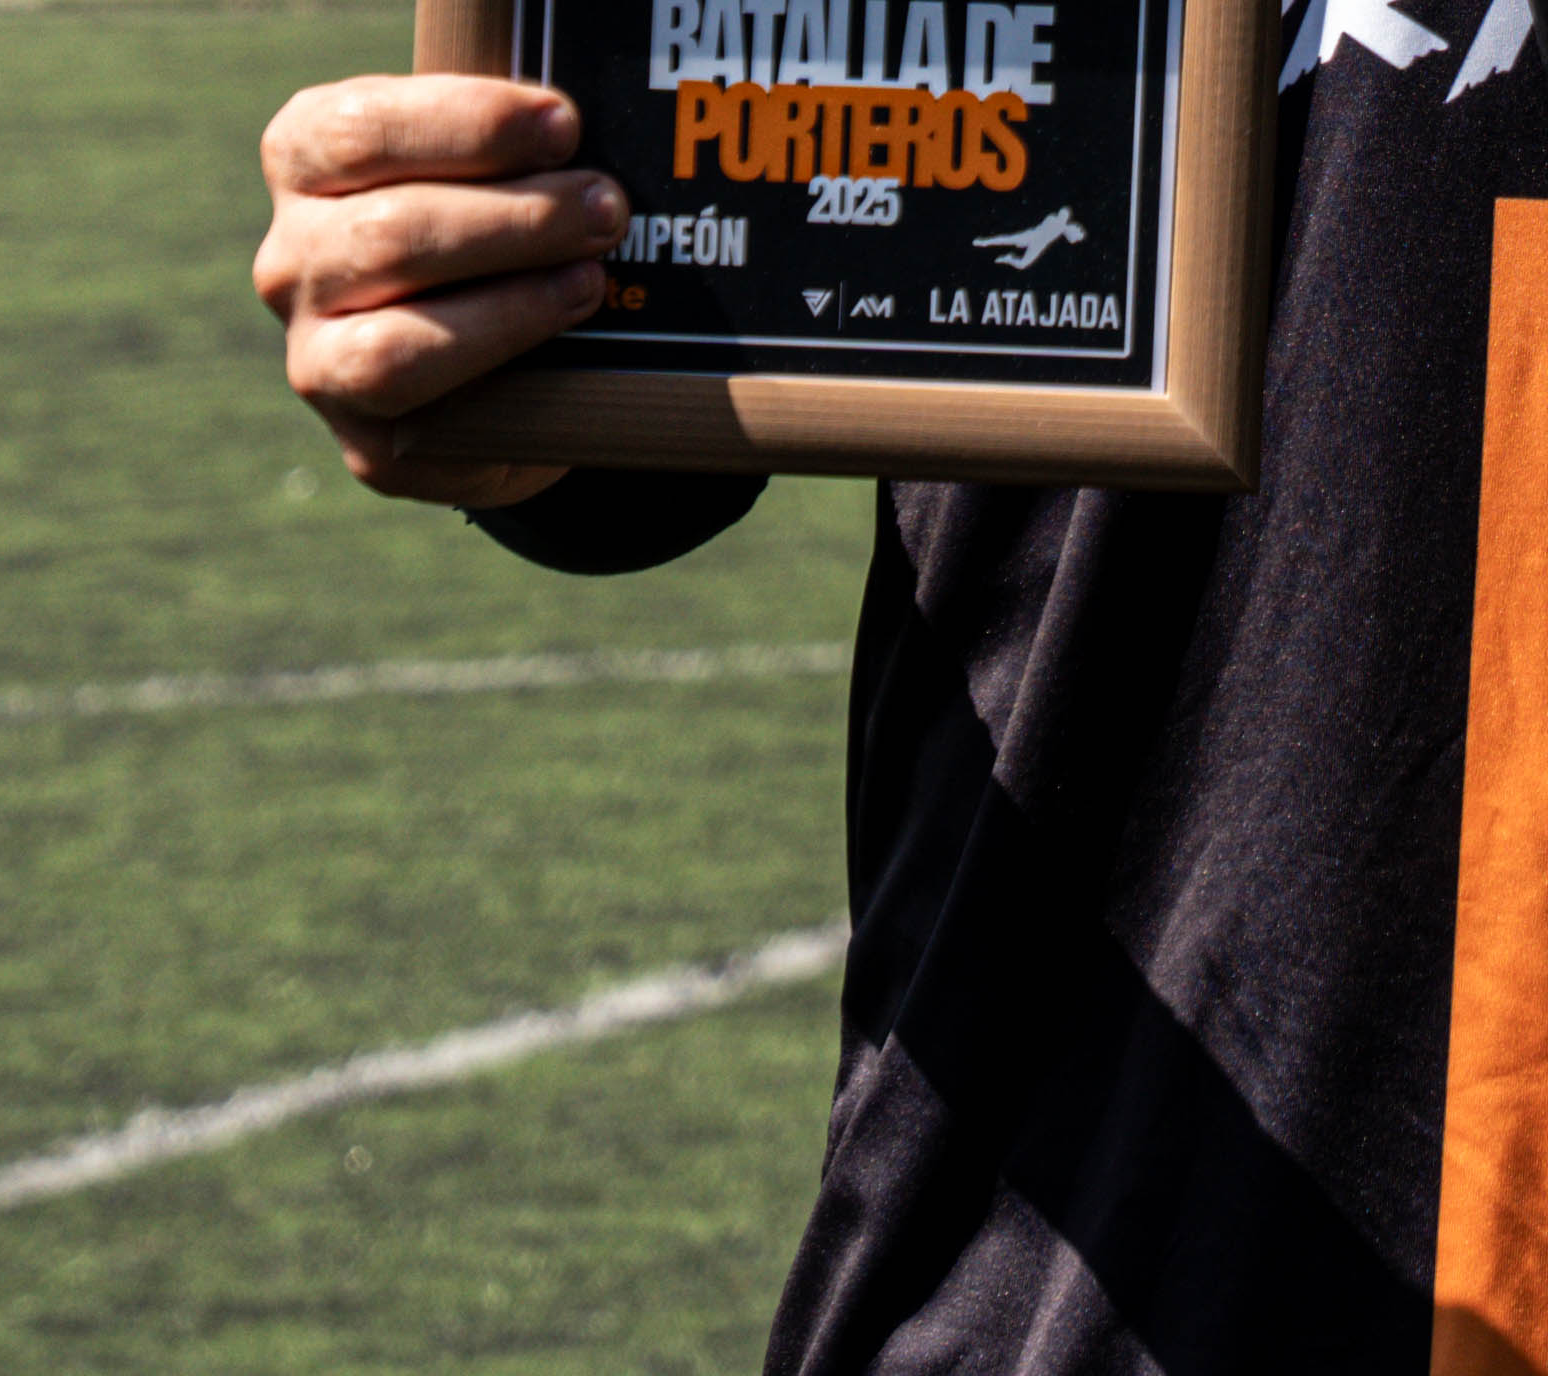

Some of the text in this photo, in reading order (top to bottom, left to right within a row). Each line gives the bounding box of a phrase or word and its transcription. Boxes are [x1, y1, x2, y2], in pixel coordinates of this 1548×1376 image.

[963, 1, 1054, 105] DE
[673, 79, 1029, 192] PORTEROS
[806, 175, 901, 227] 2025
[606, 204, 749, 267] MPEÓN
[929, 287, 1121, 331] LA ATAJADA
